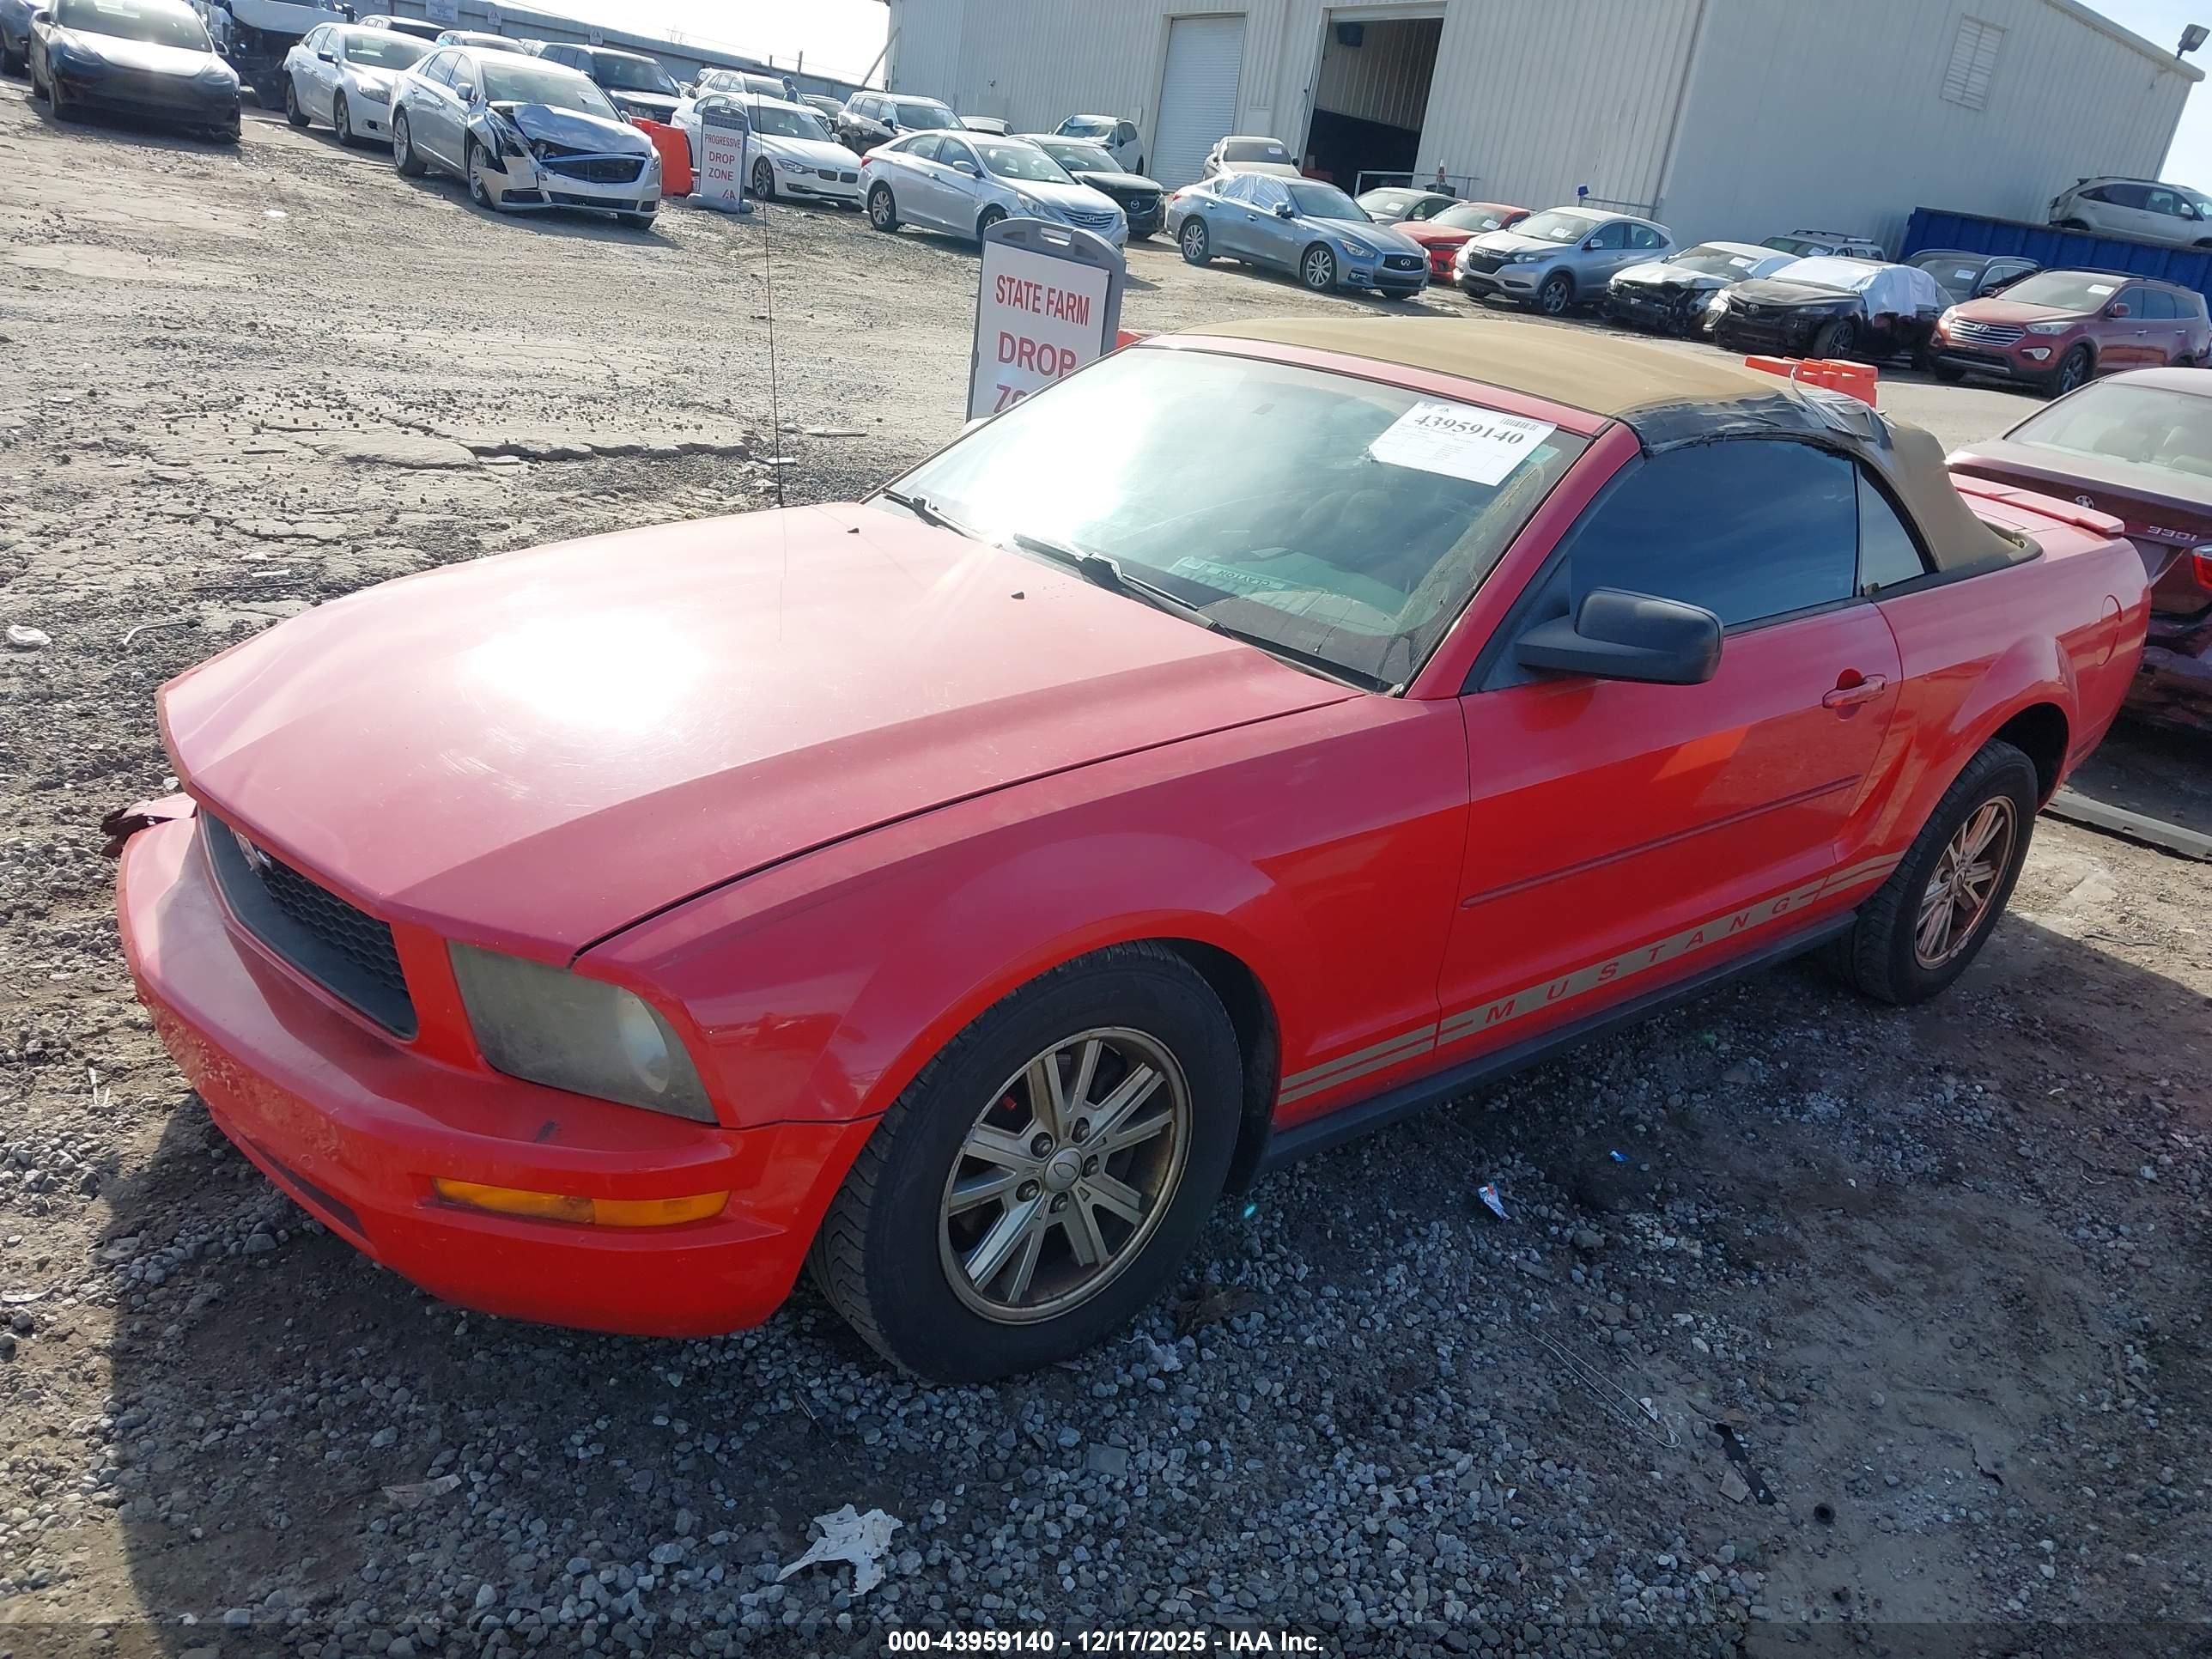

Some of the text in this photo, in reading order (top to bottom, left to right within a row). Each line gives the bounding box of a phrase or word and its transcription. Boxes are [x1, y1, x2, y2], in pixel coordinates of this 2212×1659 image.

[704, 133, 741, 149] PROGRESSIVE
[708, 151, 735, 165] DROP
[708, 167, 733, 181] ZONE
[996, 274, 1091, 326] STATE FARM
[998, 331, 1077, 378] DROP
[1414, 415, 1525, 445] 43959140
[1485, 896, 1791, 1024] MUSTANG
